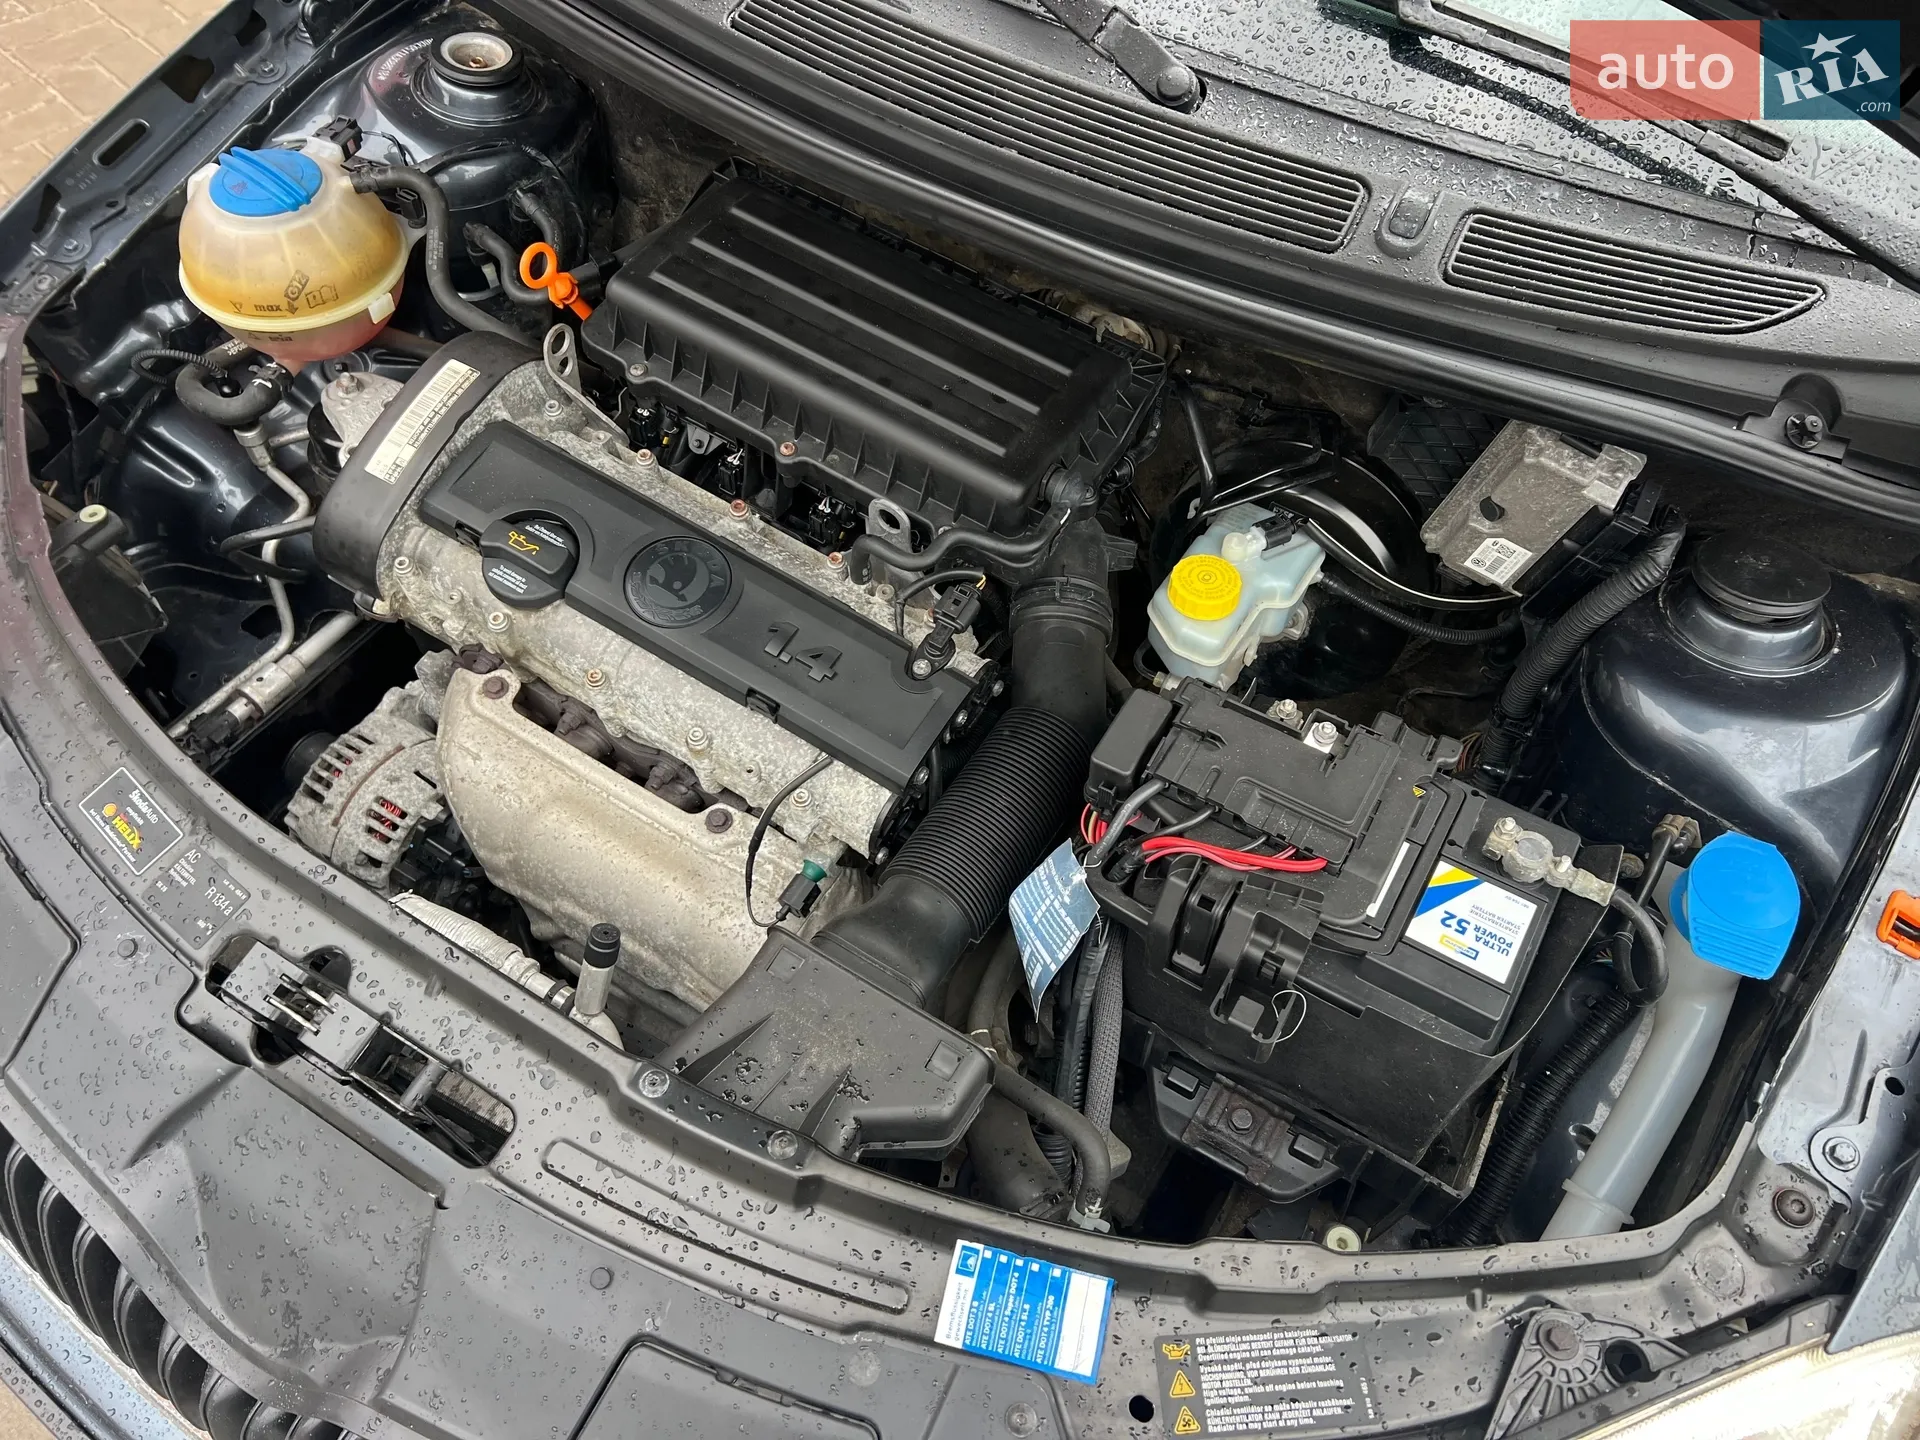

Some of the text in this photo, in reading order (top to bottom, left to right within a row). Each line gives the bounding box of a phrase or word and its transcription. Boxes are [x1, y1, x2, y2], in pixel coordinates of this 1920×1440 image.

[253, 303, 283, 312] max
[764, 621, 843, 682] 1.4
[130, 790, 158, 823] ŠkodaAuto
[112, 816, 140, 849] HELIX
[185, 849, 201, 863] AC
[1470, 909, 1518, 935] STARTERBATTERIE
[1472, 905, 1520, 930] STARTER BATTERY
[1441, 911, 1509, 956] ULTRA 52
[1474, 925, 1513, 948] POWER
[1009, 1277, 1018, 1294] DOT
[1005, 1295, 1014, 1315] Super
[1043, 1310, 1051, 1325] TYP
[1000, 1321, 1008, 1338] DOT
[997, 1339, 1005, 1353] ATE
[1039, 1331, 1047, 1348] DOT
[1225, 1335, 1241, 1344] oleje
[1251, 1340, 1274, 1349] BESTEHT
[1274, 1339, 1295, 1347] GEFAHR
[1036, 1349, 1044, 1363] ATE
[1198, 1352, 1228, 1362] Overfilled
[1229, 1351, 1250, 1360] engine
[1272, 1347, 1296, 1355] damage
[1297, 1345, 1324, 1354] catalyst.
[1259, 1367, 1288, 1377] BERÜHREN
[1301, 1363, 1336, 1374] ZÜNDANLAGE
[1261, 1359, 1288, 1368] dotykem
[1288, 1357, 1313, 1366] vypnout
[1202, 1378, 1254, 1389] MOTOR ABSTELLEN.
[1203, 1390, 1218, 1398] High
[1218, 1386, 1244, 1396] voltage,
[1245, 1383, 1265, 1394] switch
[1275, 1383, 1296, 1392] engine
[1296, 1381, 1317, 1390] before
[1317, 1379, 1344, 1388] touching
[1228, 1395, 1252, 1404] system.
[1264, 1412, 1281, 1421] KANN
[1281, 1409, 1311, 1419] JEDERZEIT
[1312, 1406, 1344, 1417] ANLAUFEN.
[1208, 1424, 1235, 1433] Radiator
[1248, 1422, 1262, 1431] may
[1263, 1420, 1278, 1429] start
[1299, 1417, 1317, 1425] time.
